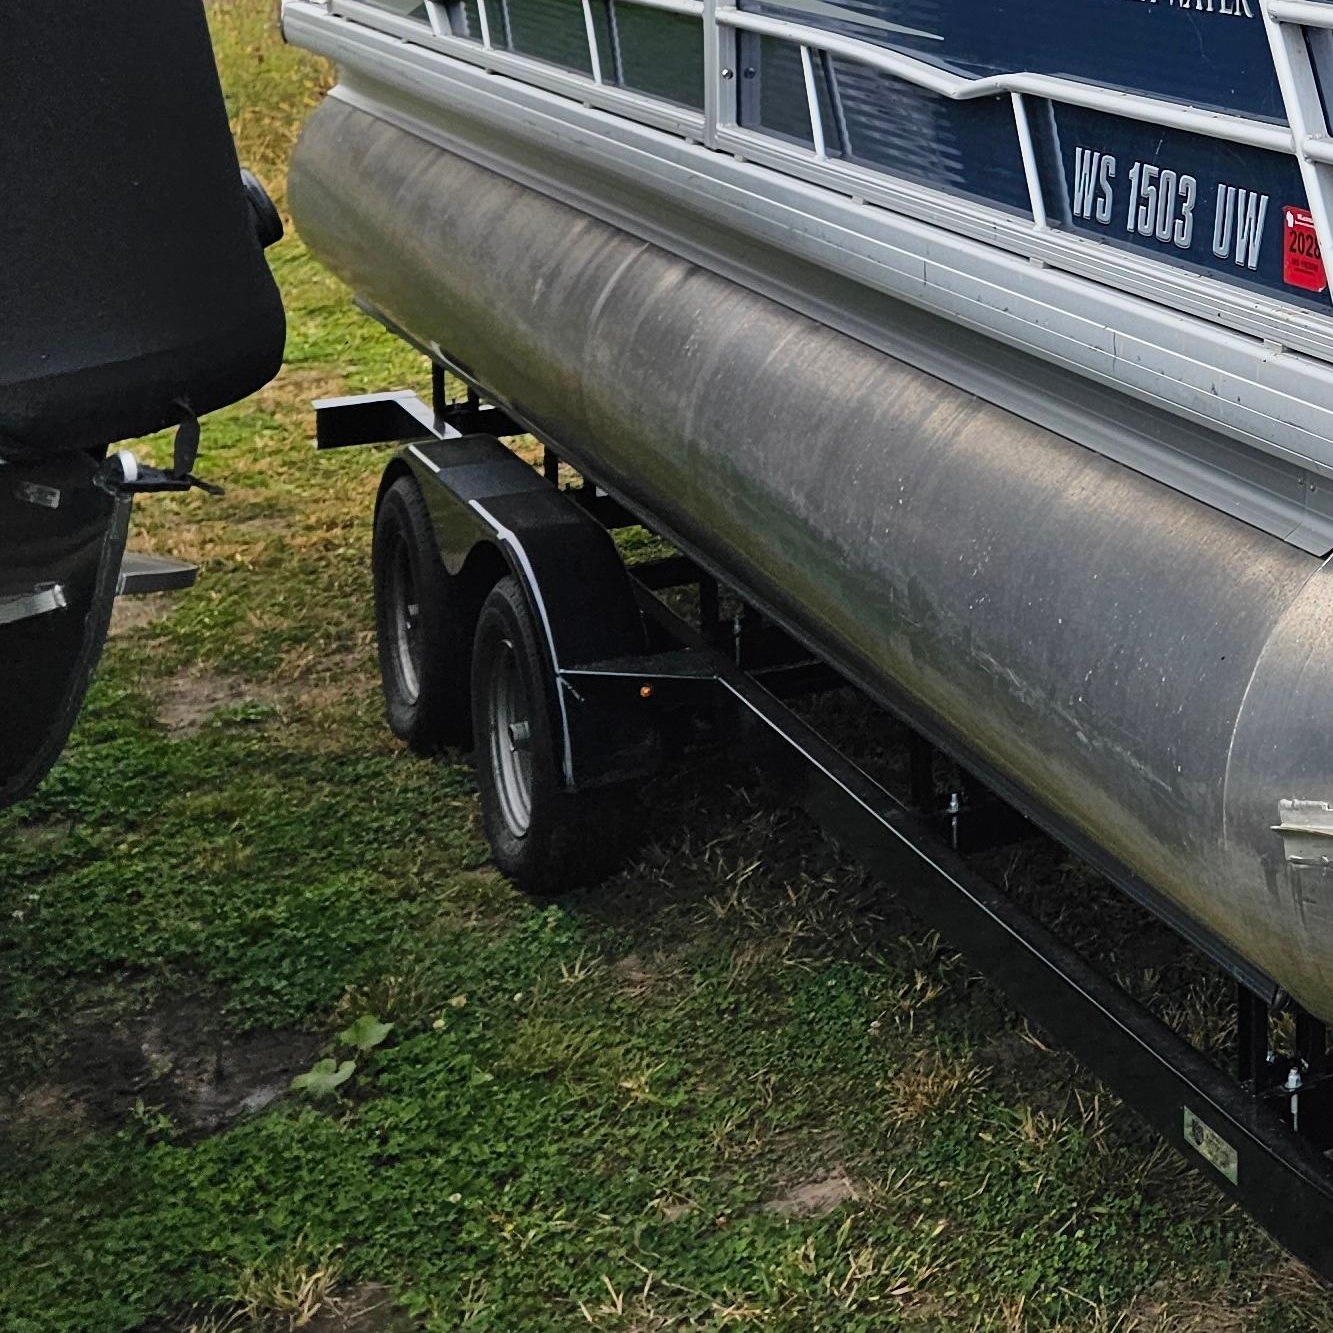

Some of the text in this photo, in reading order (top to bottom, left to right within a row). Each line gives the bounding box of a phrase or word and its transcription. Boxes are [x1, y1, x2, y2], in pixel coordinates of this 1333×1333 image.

[1073, 146, 1270, 271] WS 1503 UW
